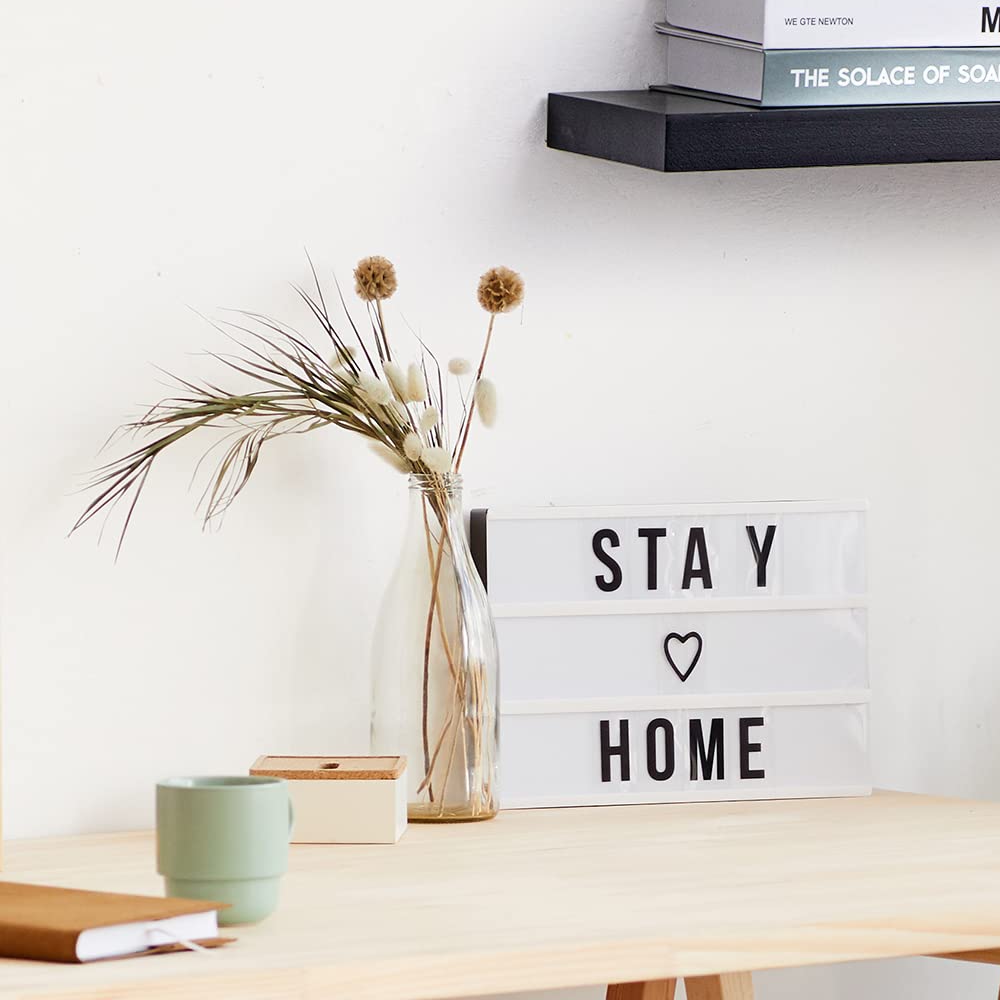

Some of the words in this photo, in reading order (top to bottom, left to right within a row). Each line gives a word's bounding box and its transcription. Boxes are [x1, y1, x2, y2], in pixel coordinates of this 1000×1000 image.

[784, 17, 798, 26] WE
[799, 17, 816, 26] GTE
[818, 16, 854, 26] NEWTON
[790, 68, 829, 88] THE
[837, 66, 915, 87] SOLACE
[922, 65, 951, 85] OF
[591, 524, 777, 593] STAY
[599, 716, 766, 783] HOME
